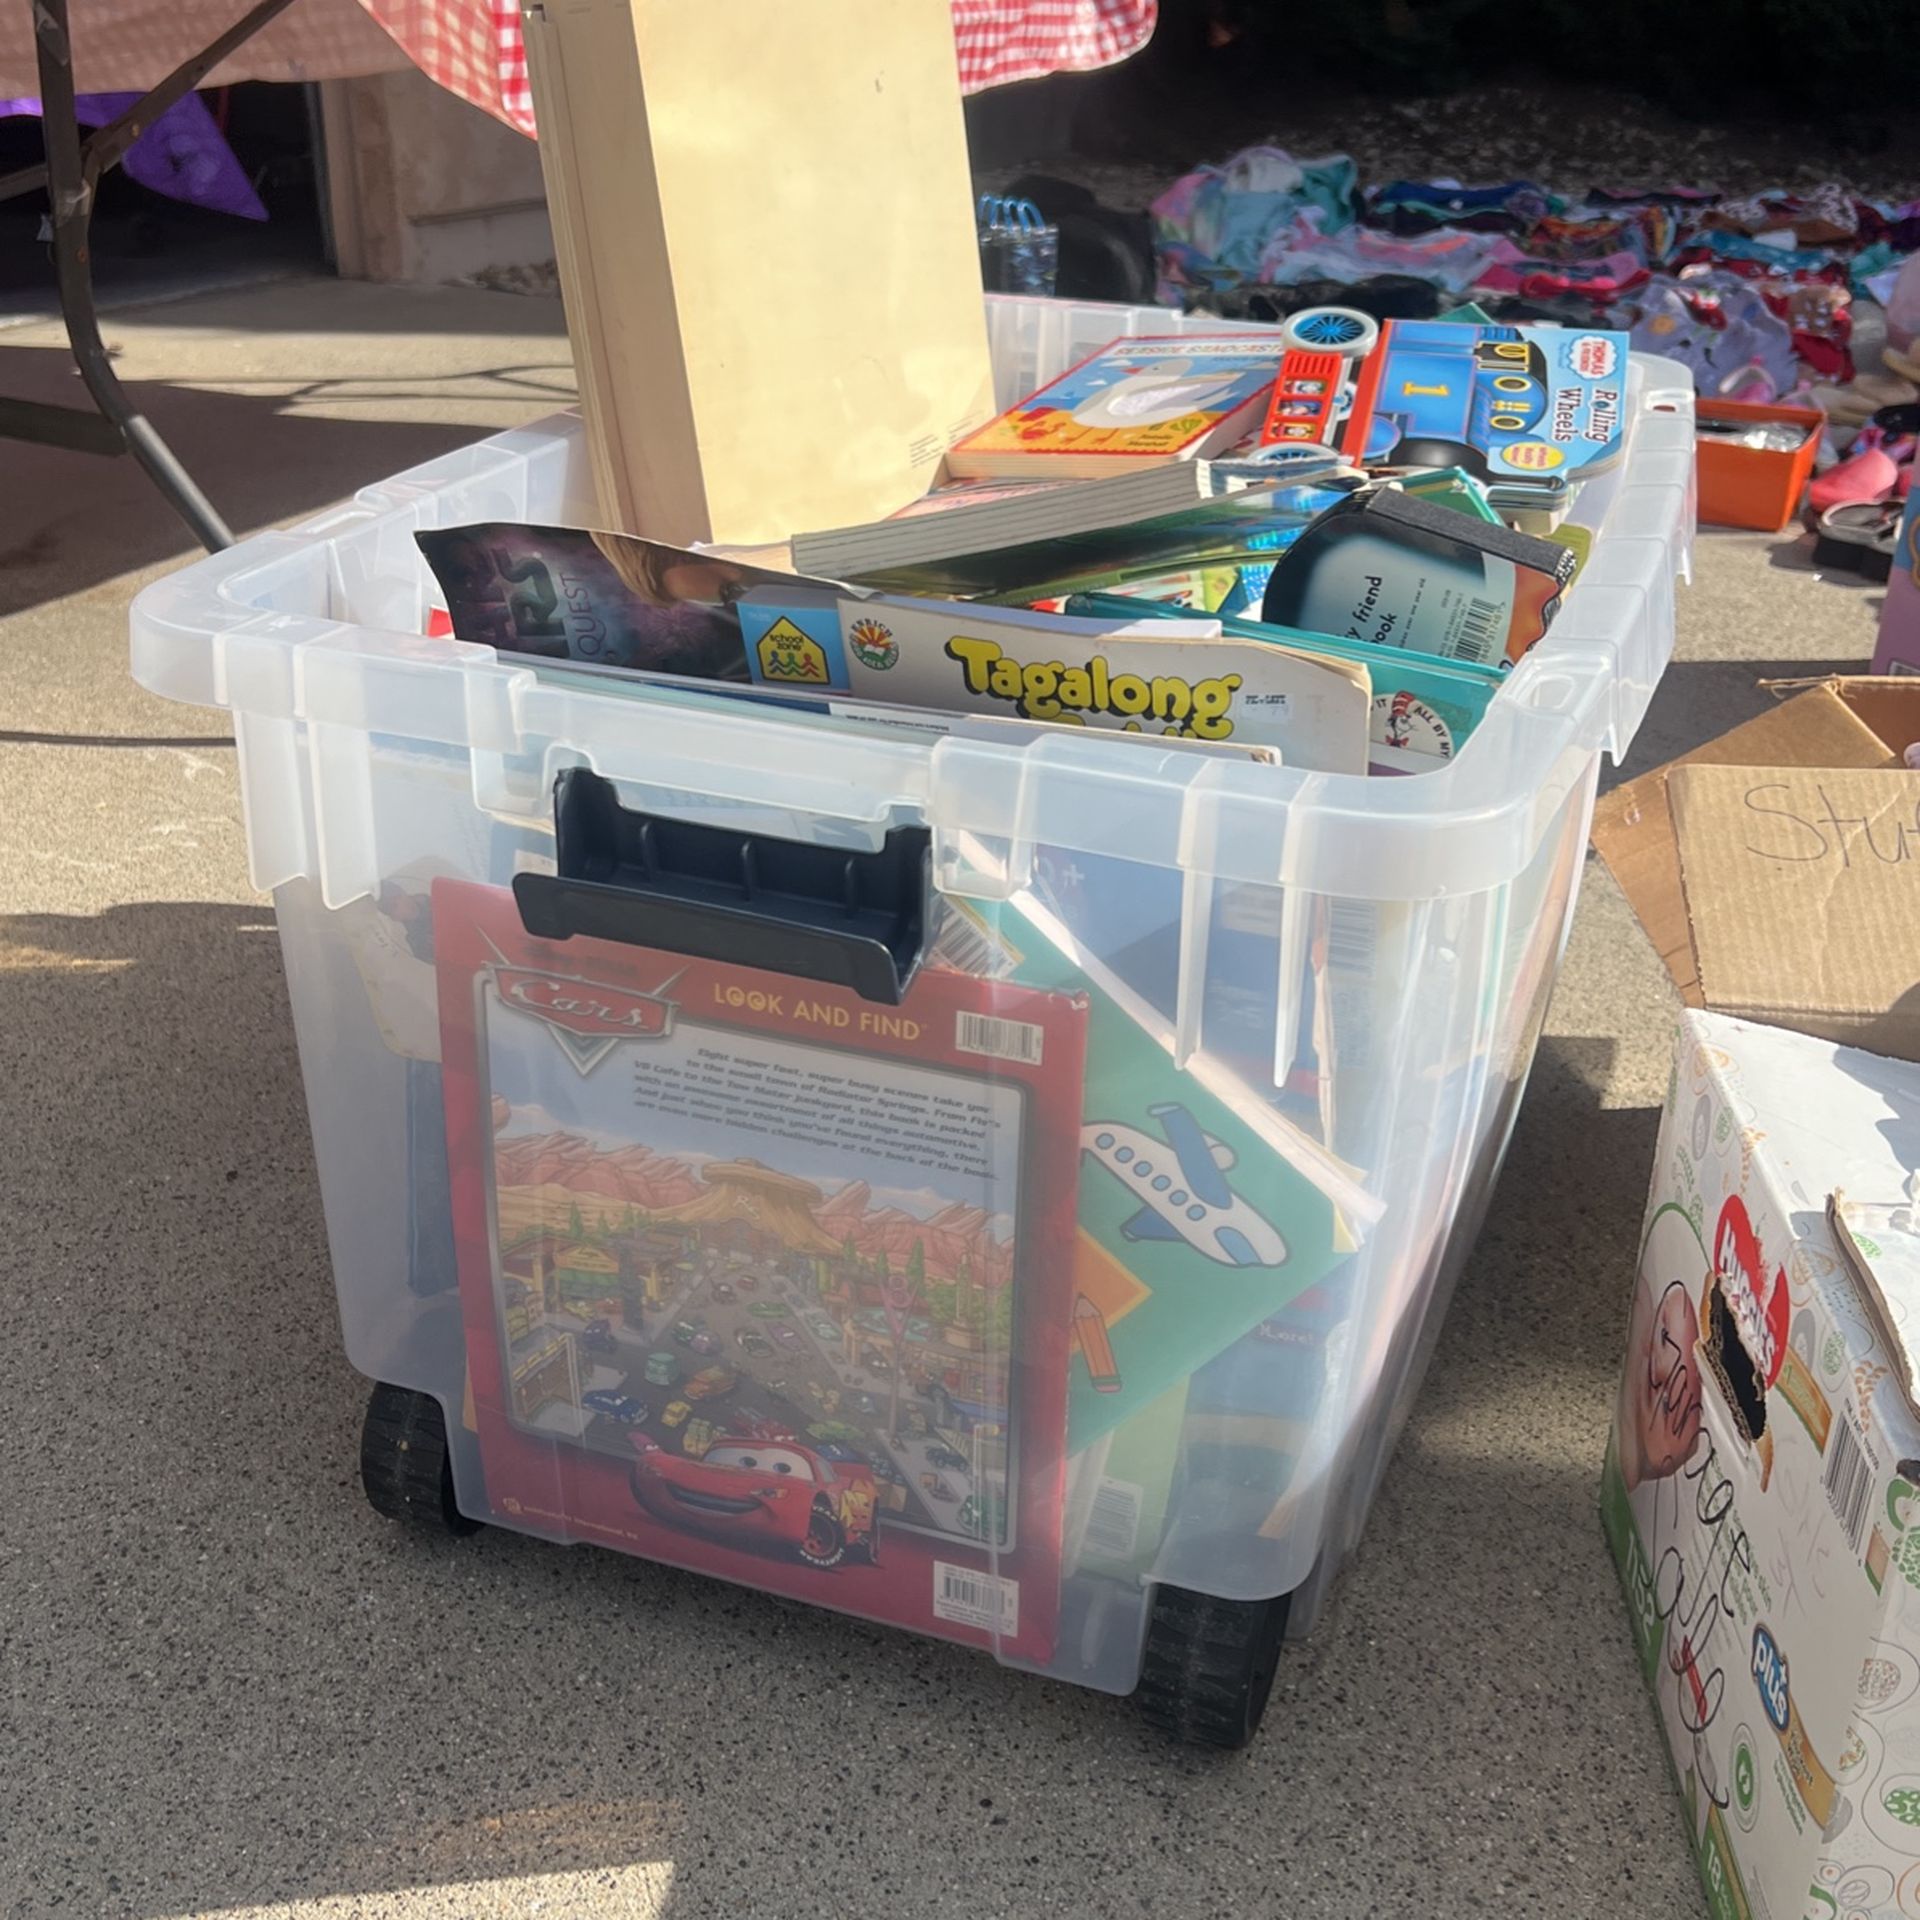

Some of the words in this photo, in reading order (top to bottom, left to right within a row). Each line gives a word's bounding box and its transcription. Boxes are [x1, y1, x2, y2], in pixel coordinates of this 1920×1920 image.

[1554, 387, 1582, 441] Wheels
[1585, 388, 1618, 443] Rolling
[560, 572, 607, 655] QUEST
[1352, 575, 1383, 623] friend
[770, 634, 805, 645] school
[946, 635, 1243, 740] Tagalong
[1414, 705, 1435, 724] ALL
[1744, 784, 1920, 868] Stu
[511, 981, 649, 1030] Cars
[714, 982, 783, 1016] LOOK
[793, 1000, 851, 1028] AND
[860, 1012, 920, 1042] FIND
[684, 1071, 698, 1081] to
[702, 1074, 723, 1085] the
[753, 1086, 793, 1099] Mater
[859, 1107, 885, 1118] this
[888, 1113, 920, 1126] book
[924, 1120, 936, 1129] is
[939, 1123, 986, 1139] packed
[686, 1059, 700, 1068] to
[704, 1063, 725, 1073] the
[728, 1069, 762, 1081] small
[765, 1077, 797, 1088] town
[801, 1082, 815, 1091] of
[818, 1086, 873, 1103] Radiator
[934, 1108, 967, 1122] From
[734, 1057, 769, 1069] super
[808, 1071, 845, 1084] super
[848, 1079, 879, 1093] busy
[883, 1088, 929, 1101] scenes
[933, 1095, 963, 1108] take
[967, 1103, 990, 1113] you
[821, 1113, 836, 1121] of
[839, 1117, 855, 1126] all
[859, 1121, 899, 1135] things
[902, 1130, 981, 1151] automotive.
[835, 1127, 872, 1142] found
[954, 1152, 988, 1166] there
[841, 1143, 856, 1151] at
[860, 1146, 882, 1157] the
[919, 1159, 934, 1167] of
[937, 1162, 960, 1172] the
[1755, 1631, 1788, 1727] plus
